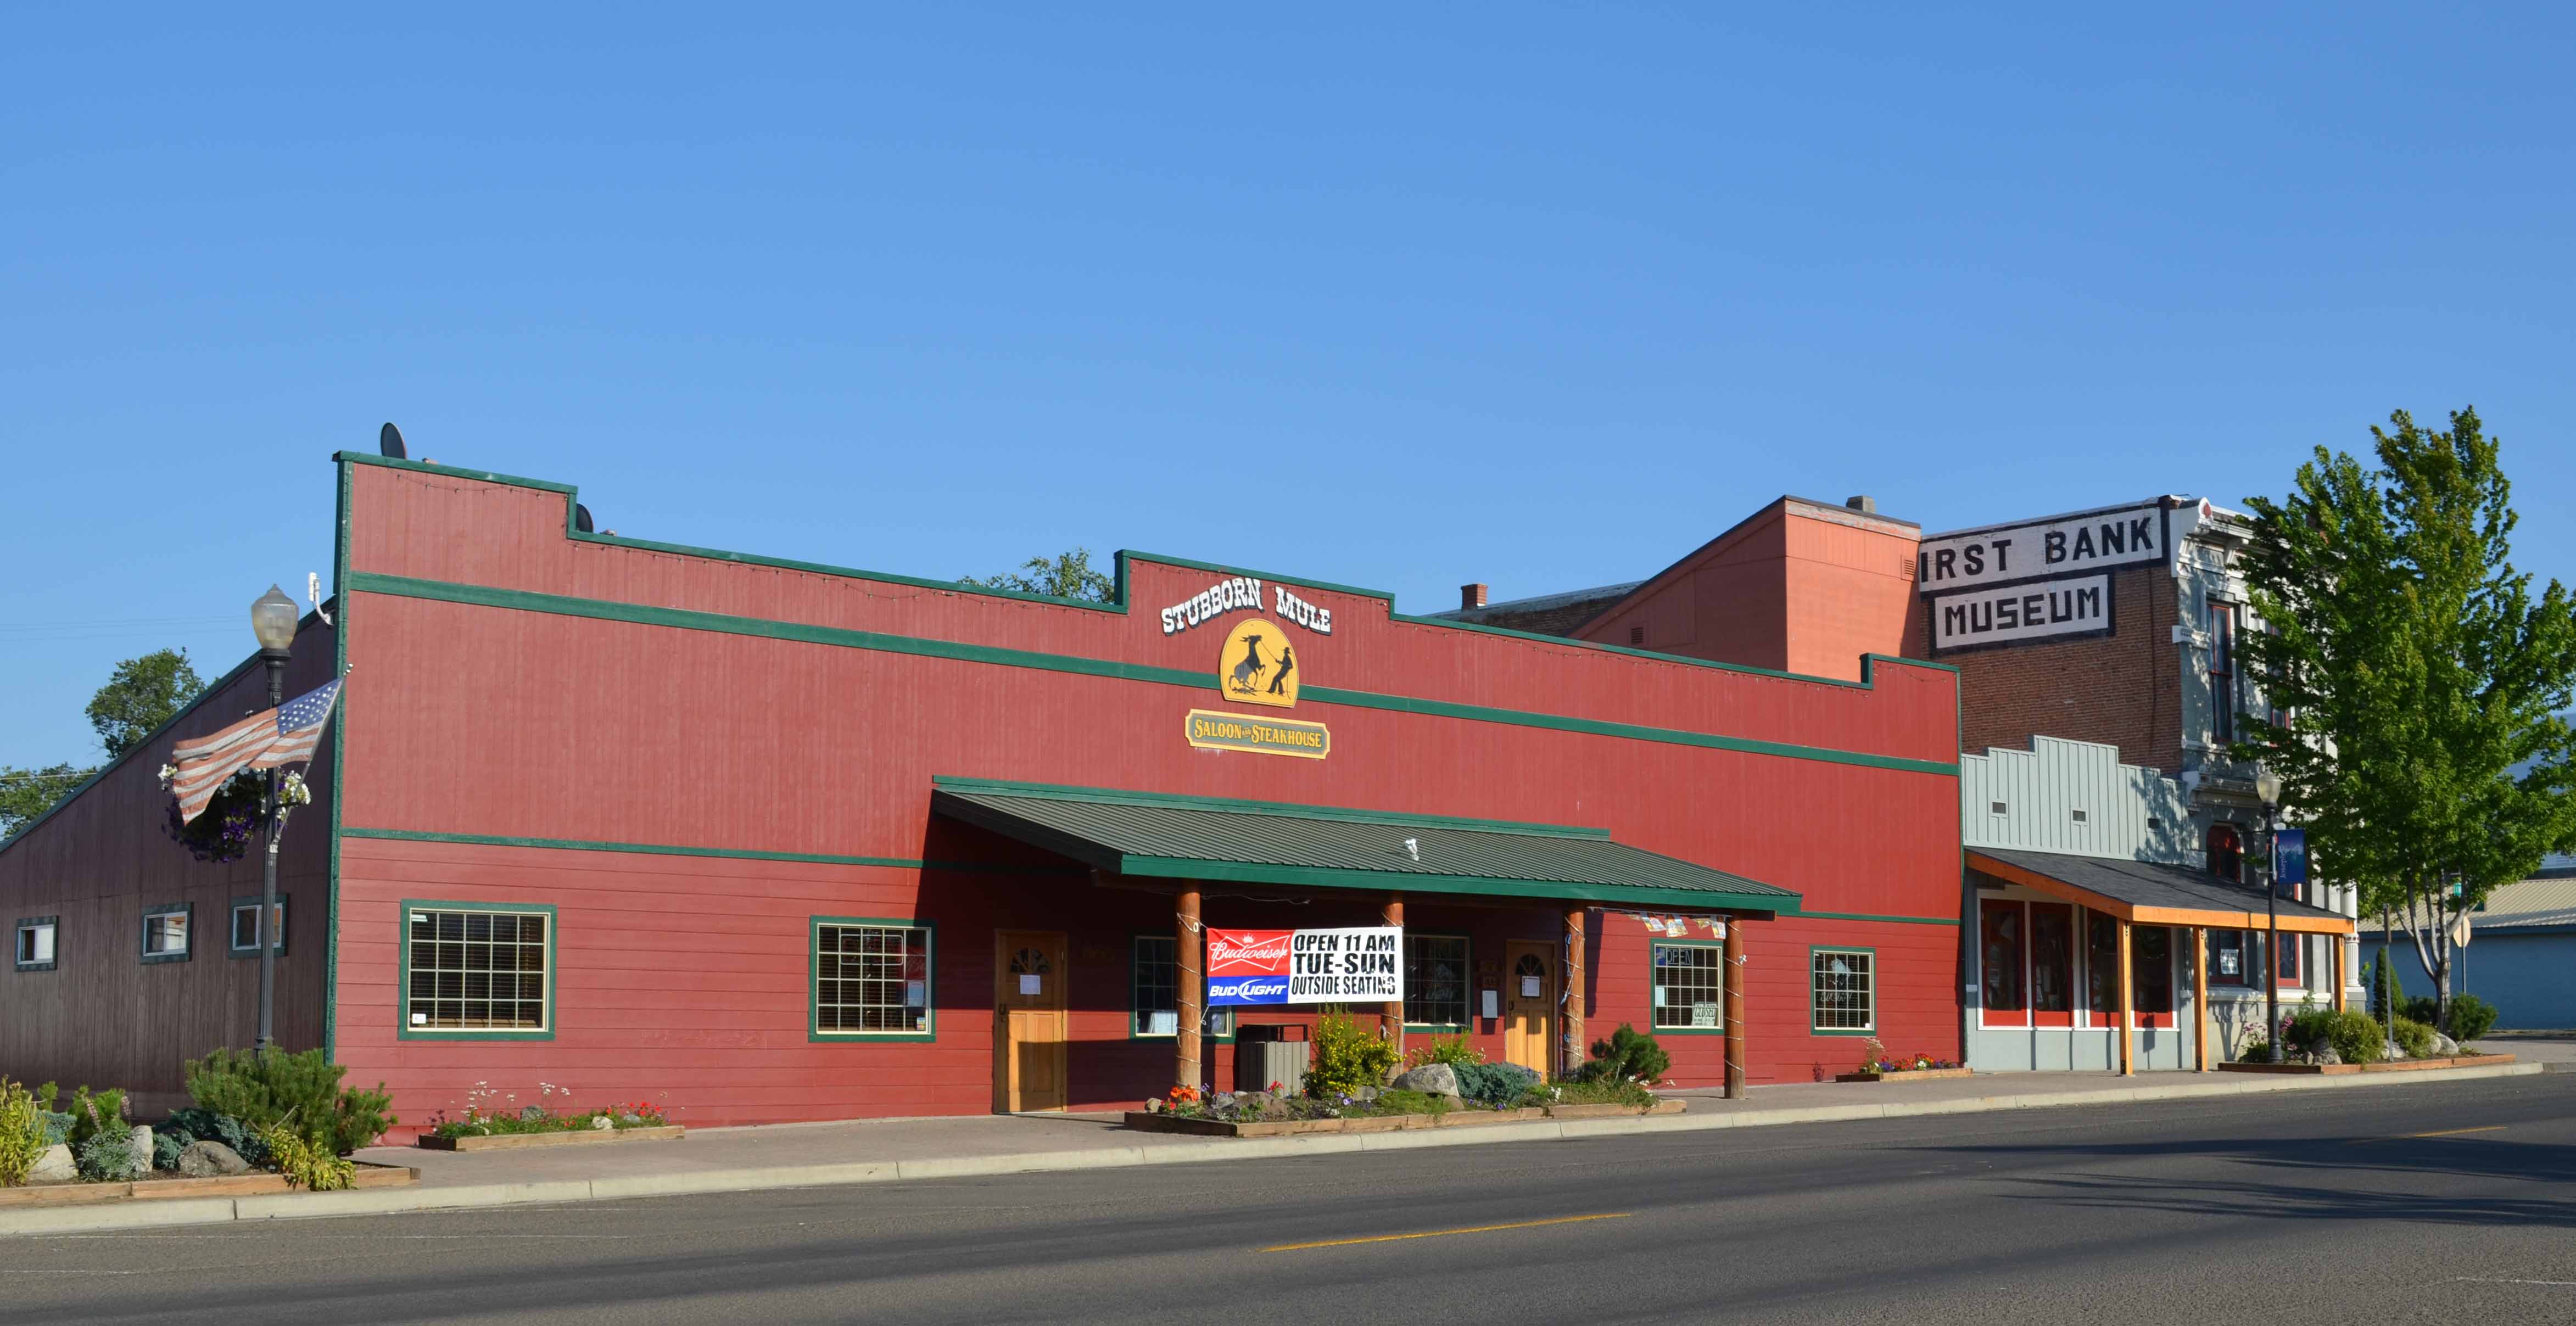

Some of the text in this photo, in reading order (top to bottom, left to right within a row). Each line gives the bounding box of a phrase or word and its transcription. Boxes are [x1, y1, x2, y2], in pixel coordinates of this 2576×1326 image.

[1920, 517, 2154, 583] IRST BANK
[1161, 577, 1331, 635] STUBBORN MULE
[1944, 586, 2100, 636] MUSEUM
[1195, 719, 1242, 739] SALOON
[1251, 724, 1322, 747] STEAKHOUSE
[1209, 942, 1288, 960] Budweiser
[1294, 935, 1395, 951] OPEN 11 AM
[1294, 953, 1395, 974] TUE-SUN
[1666, 949, 1692, 963] OPEN
[1209, 984, 1287, 997] BUD LIGHT
[1292, 976, 1395, 994] OUTSIDE SEATING
